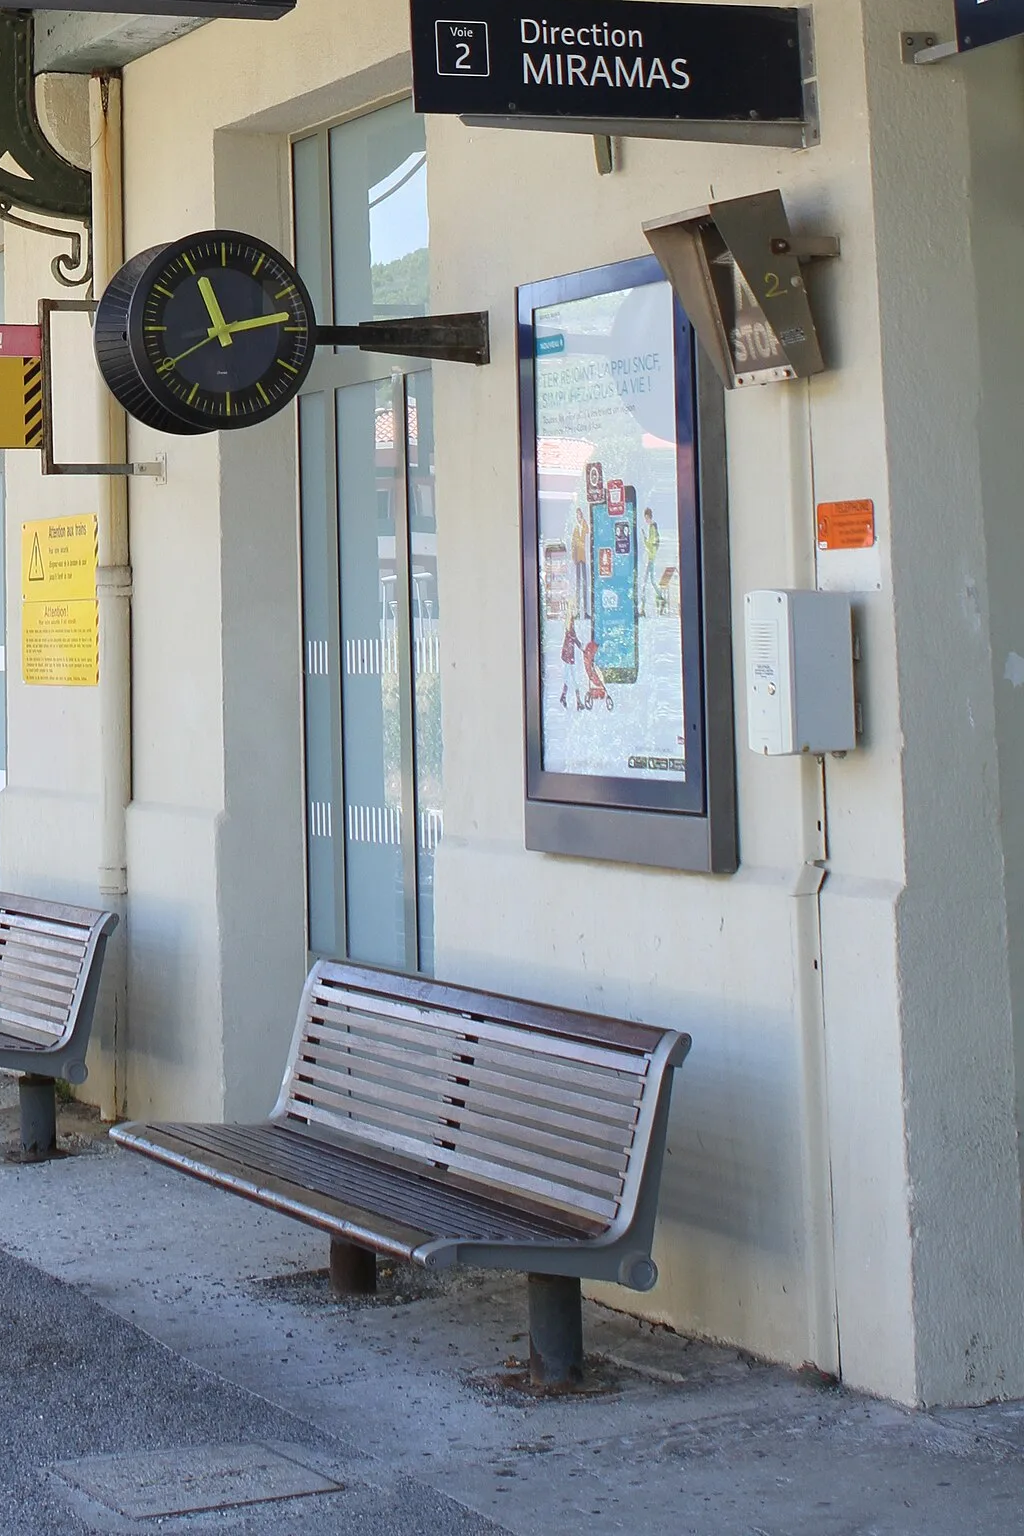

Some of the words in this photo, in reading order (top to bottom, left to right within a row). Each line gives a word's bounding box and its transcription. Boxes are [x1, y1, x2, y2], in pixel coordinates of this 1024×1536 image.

[449, 26, 474, 38] Voie
[520, 19, 644, 48] Direction
[454, 43, 472, 70] 2
[522, 52, 691, 90] MIRAMAS
[764, 272, 788, 298] 2
